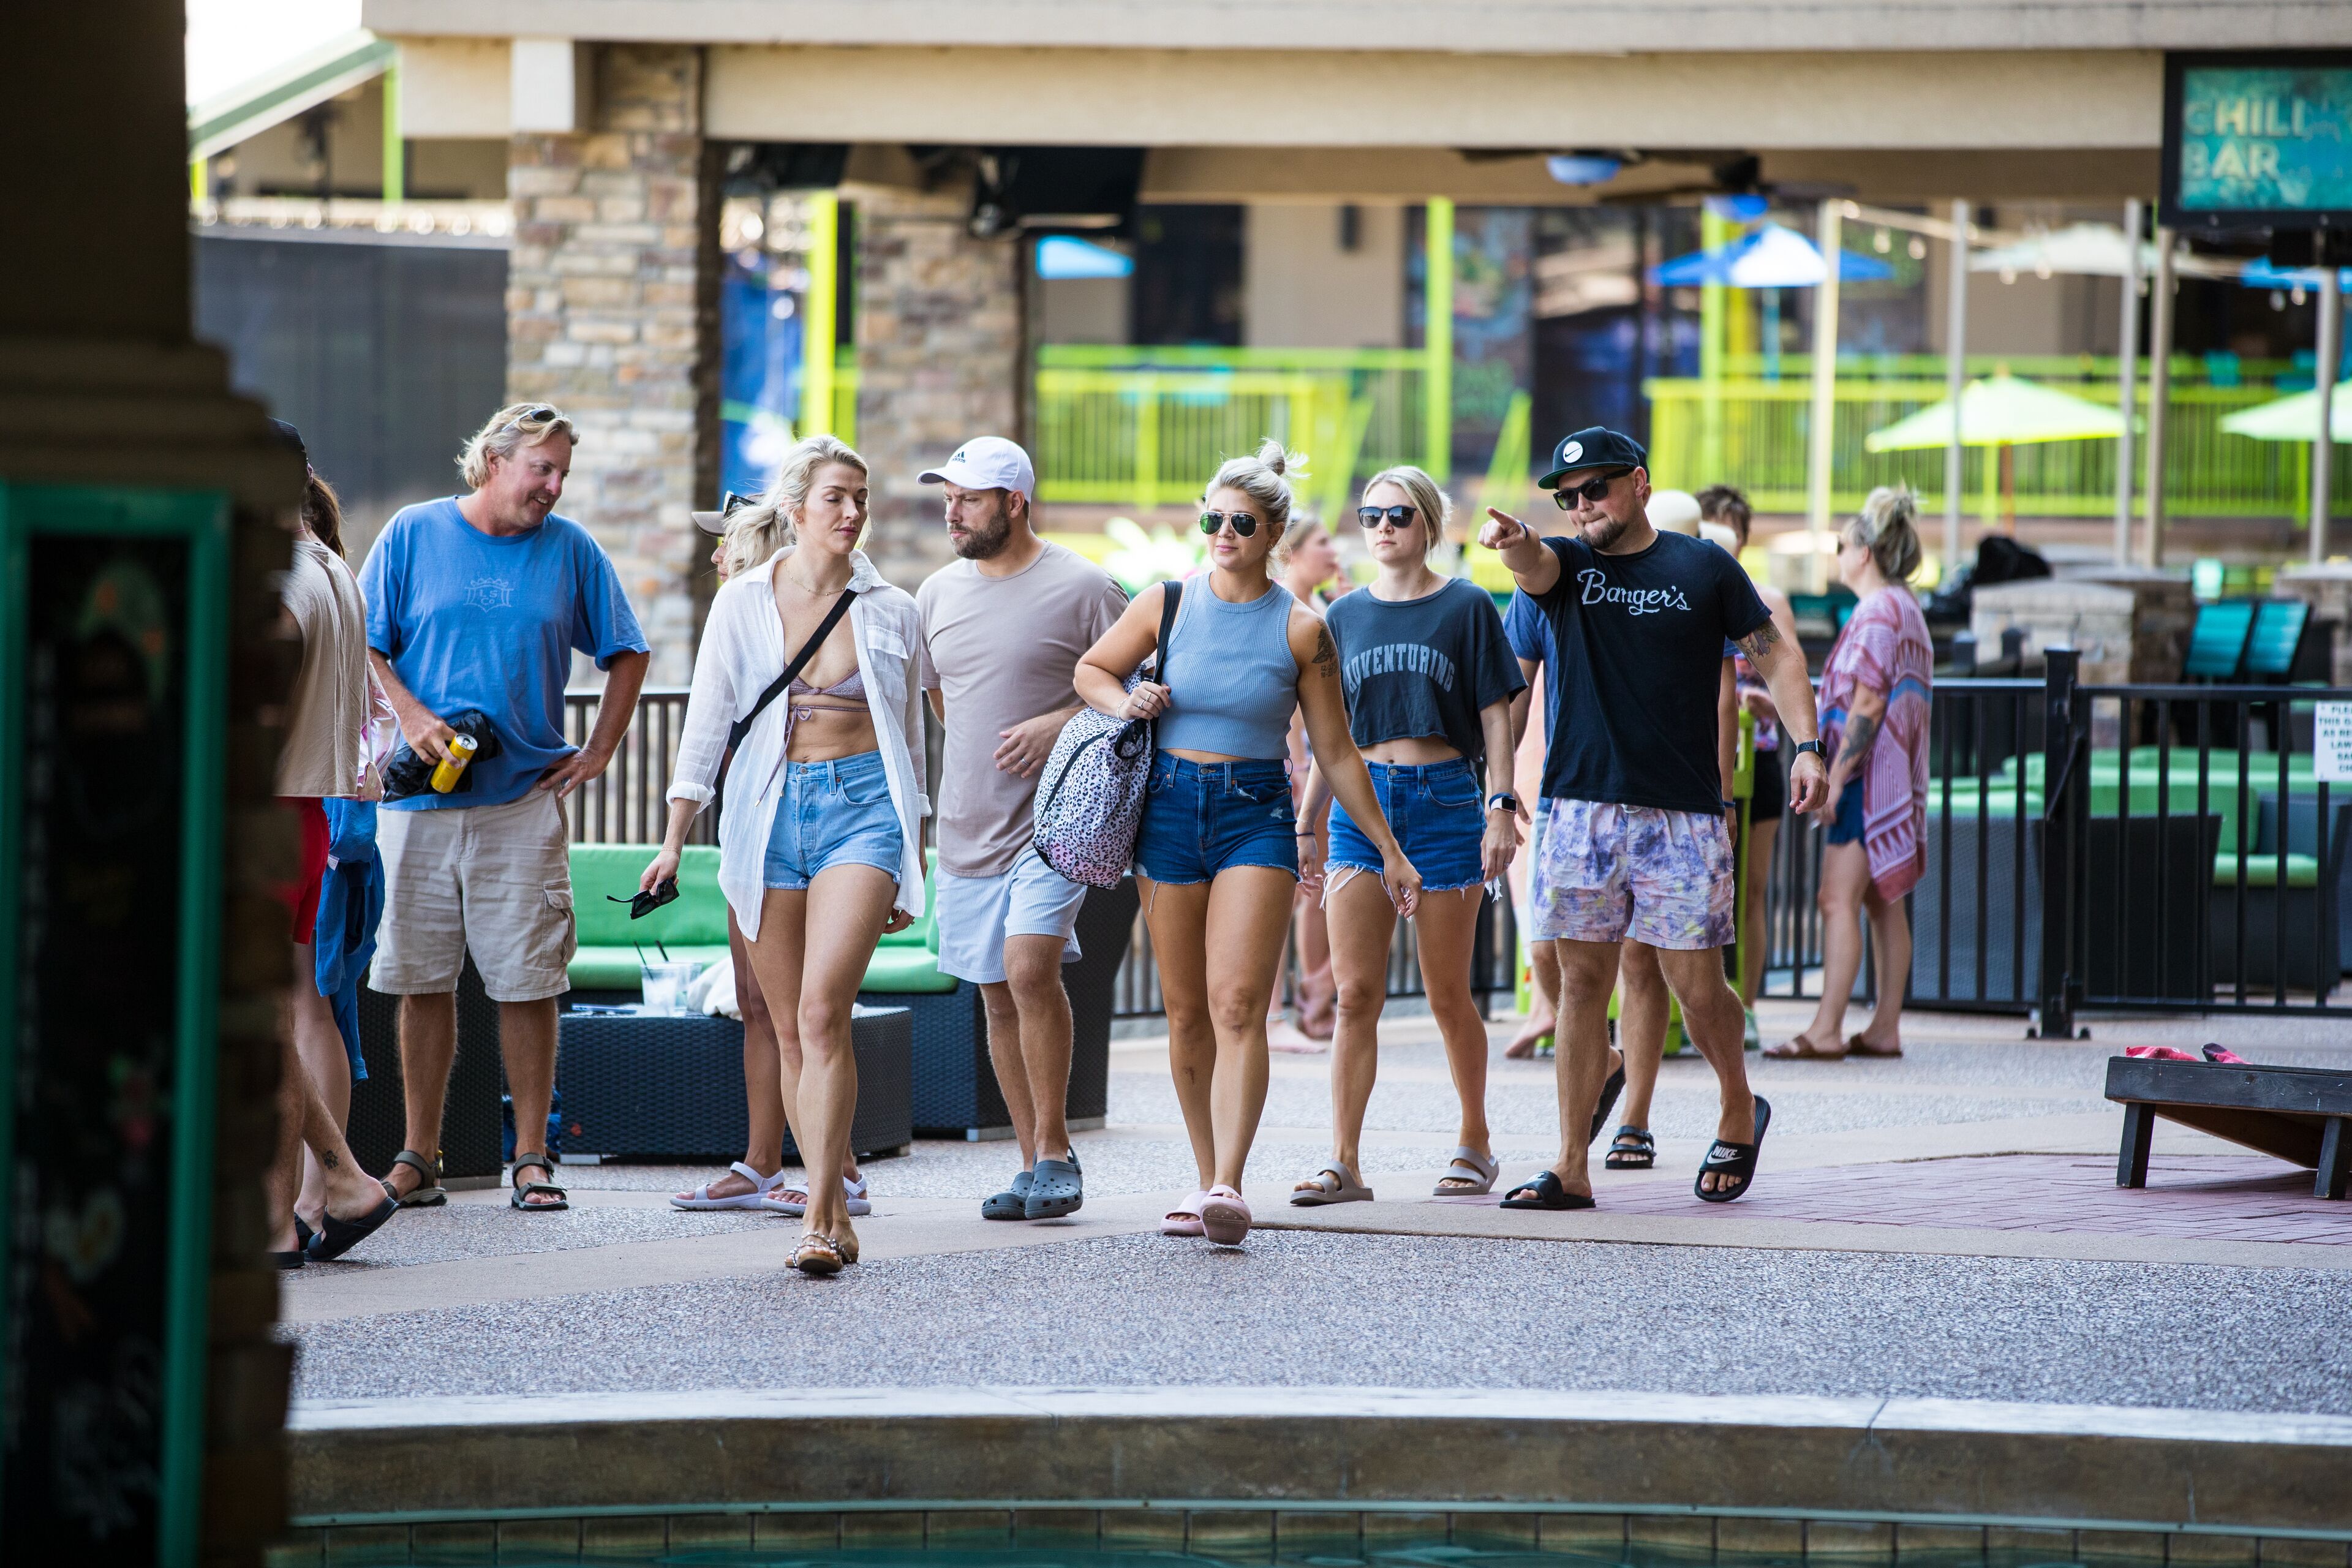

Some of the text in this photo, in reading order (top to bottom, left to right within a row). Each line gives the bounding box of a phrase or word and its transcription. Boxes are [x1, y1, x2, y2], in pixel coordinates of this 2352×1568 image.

[2184, 97, 2308, 137] CHILL
[2180, 141, 2281, 180] BAR
[1577, 568, 1692, 616] Banger's
[1346, 643, 1455, 695] ADVENTURING
[2318, 717, 2341, 725] THIS
[2331, 741, 2352, 750] LAW
[1712, 1145, 1738, 1159] NIKE
